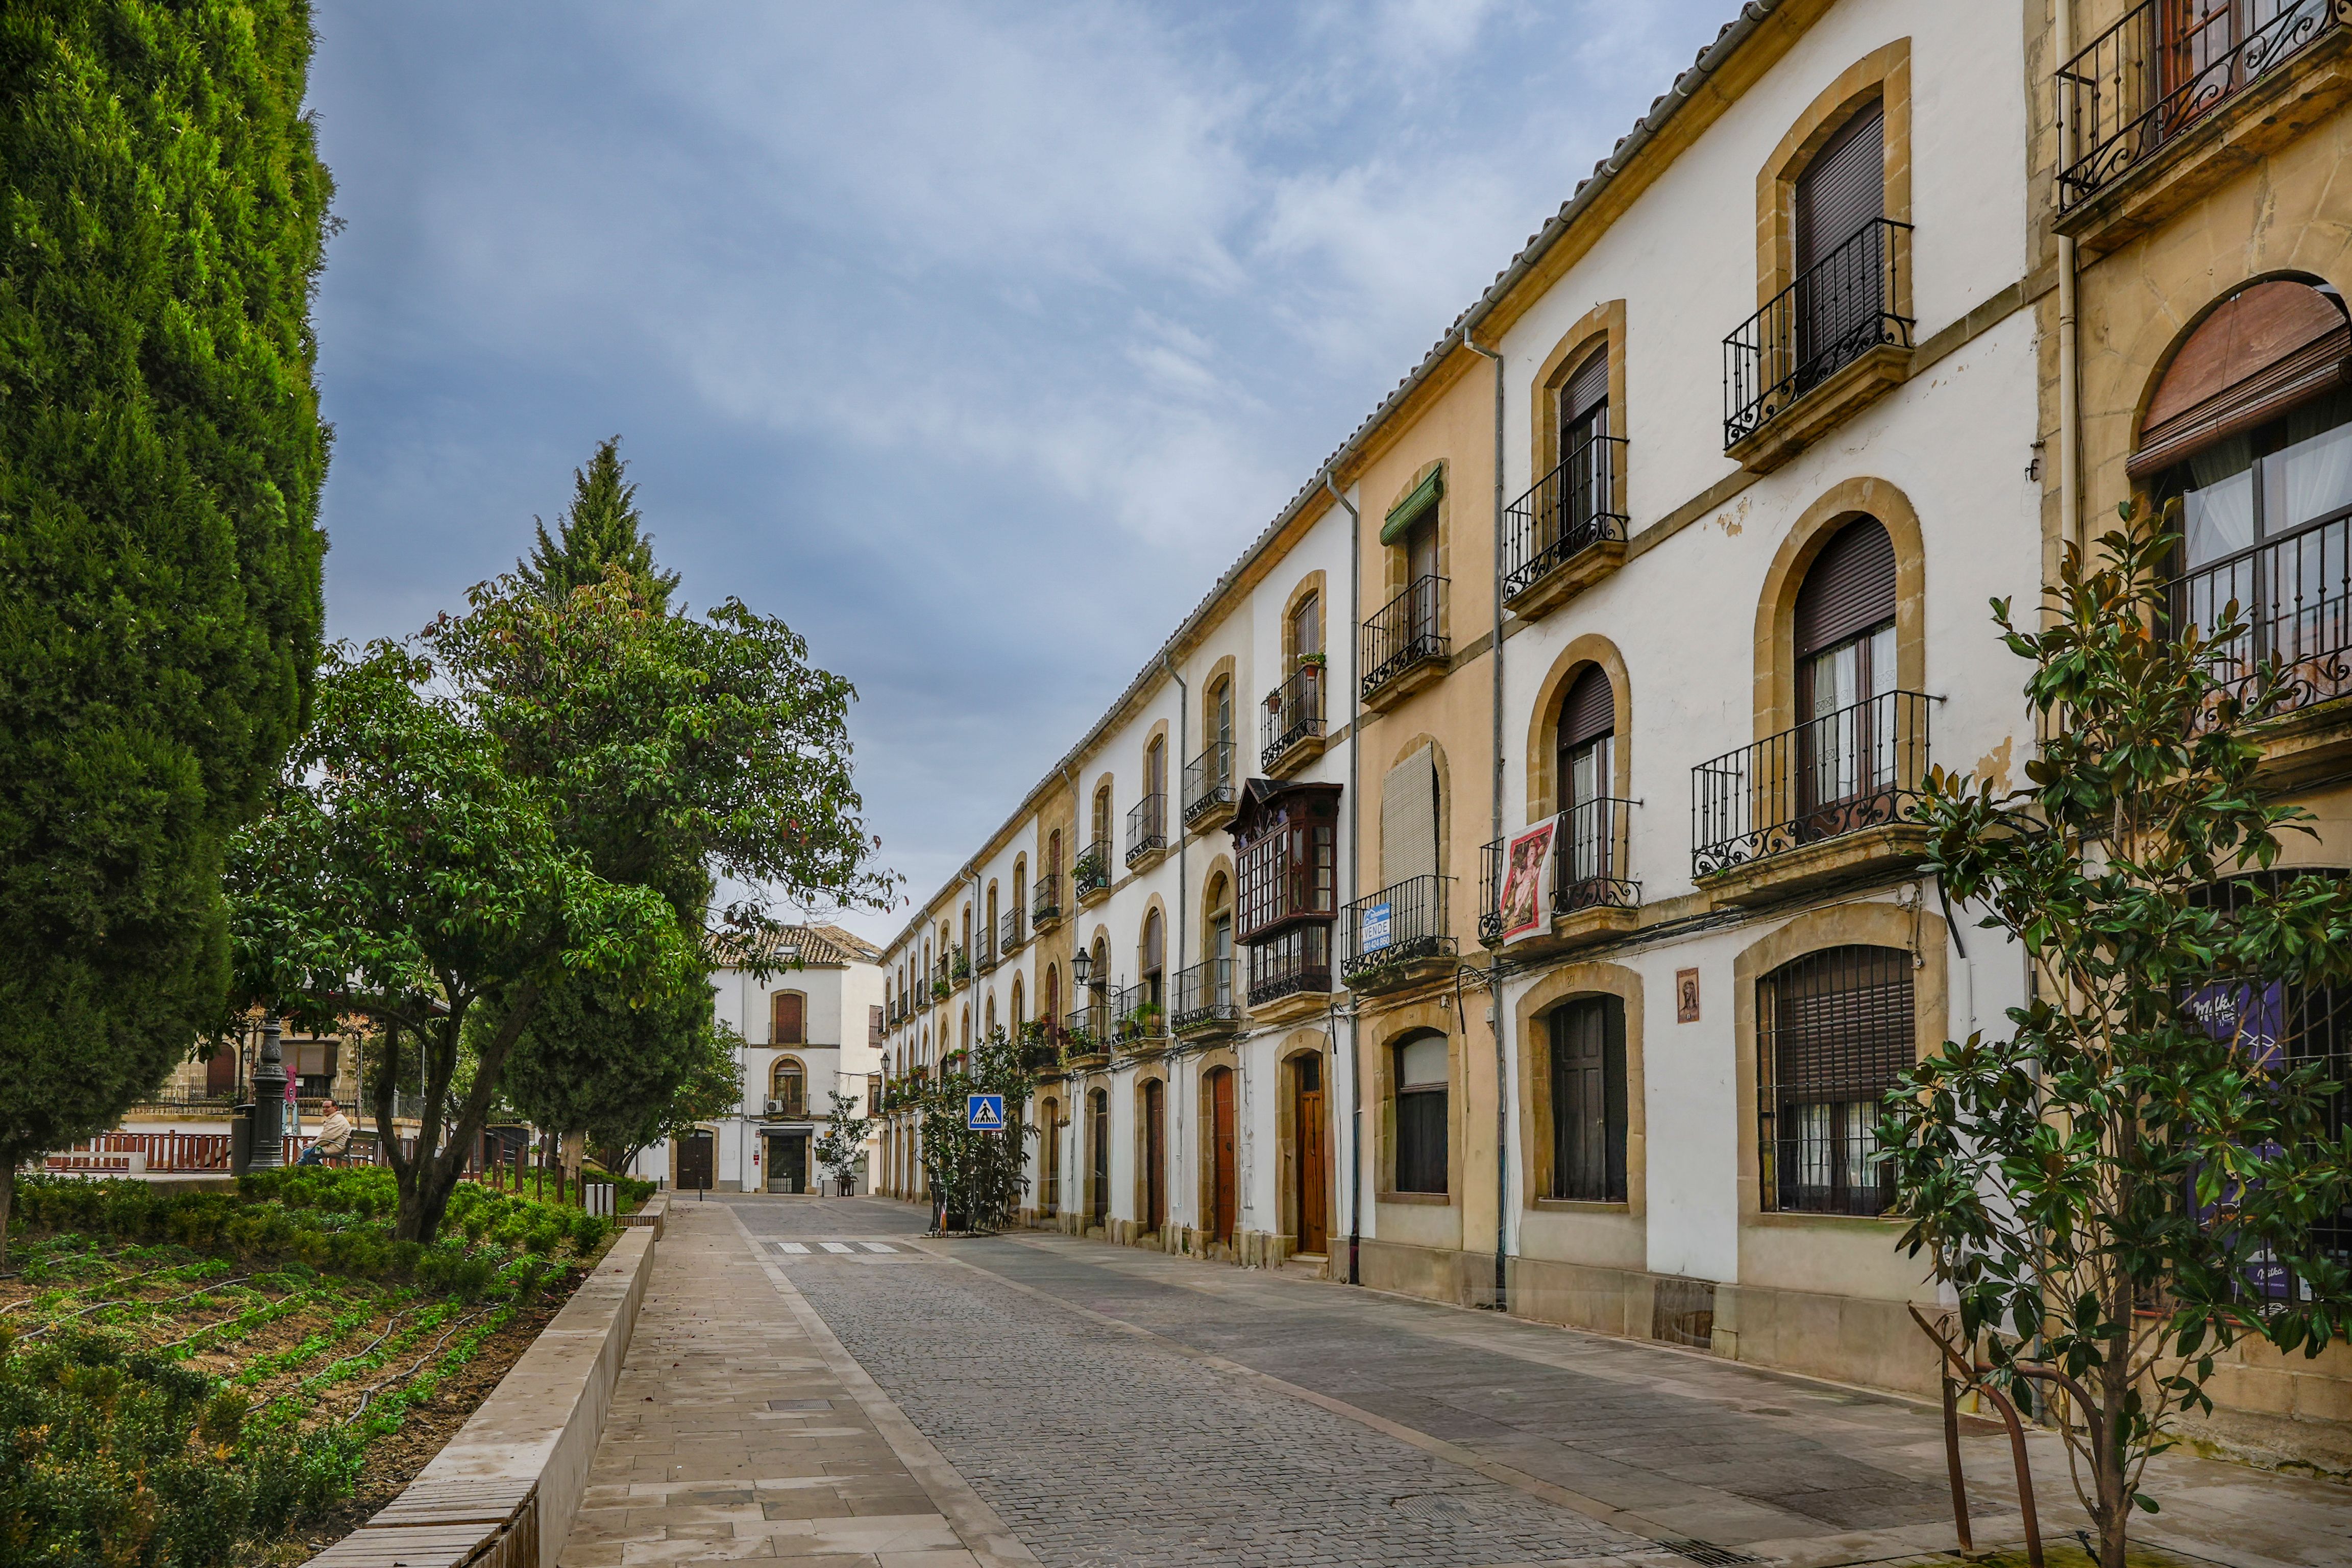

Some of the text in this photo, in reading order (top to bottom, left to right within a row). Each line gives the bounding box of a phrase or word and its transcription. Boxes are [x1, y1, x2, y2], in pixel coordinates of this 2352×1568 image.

[1364, 921, 1387, 939] VENDE
[1371, 939, 1379, 949] 424
[2257, 1267, 2284, 1280] Milka
